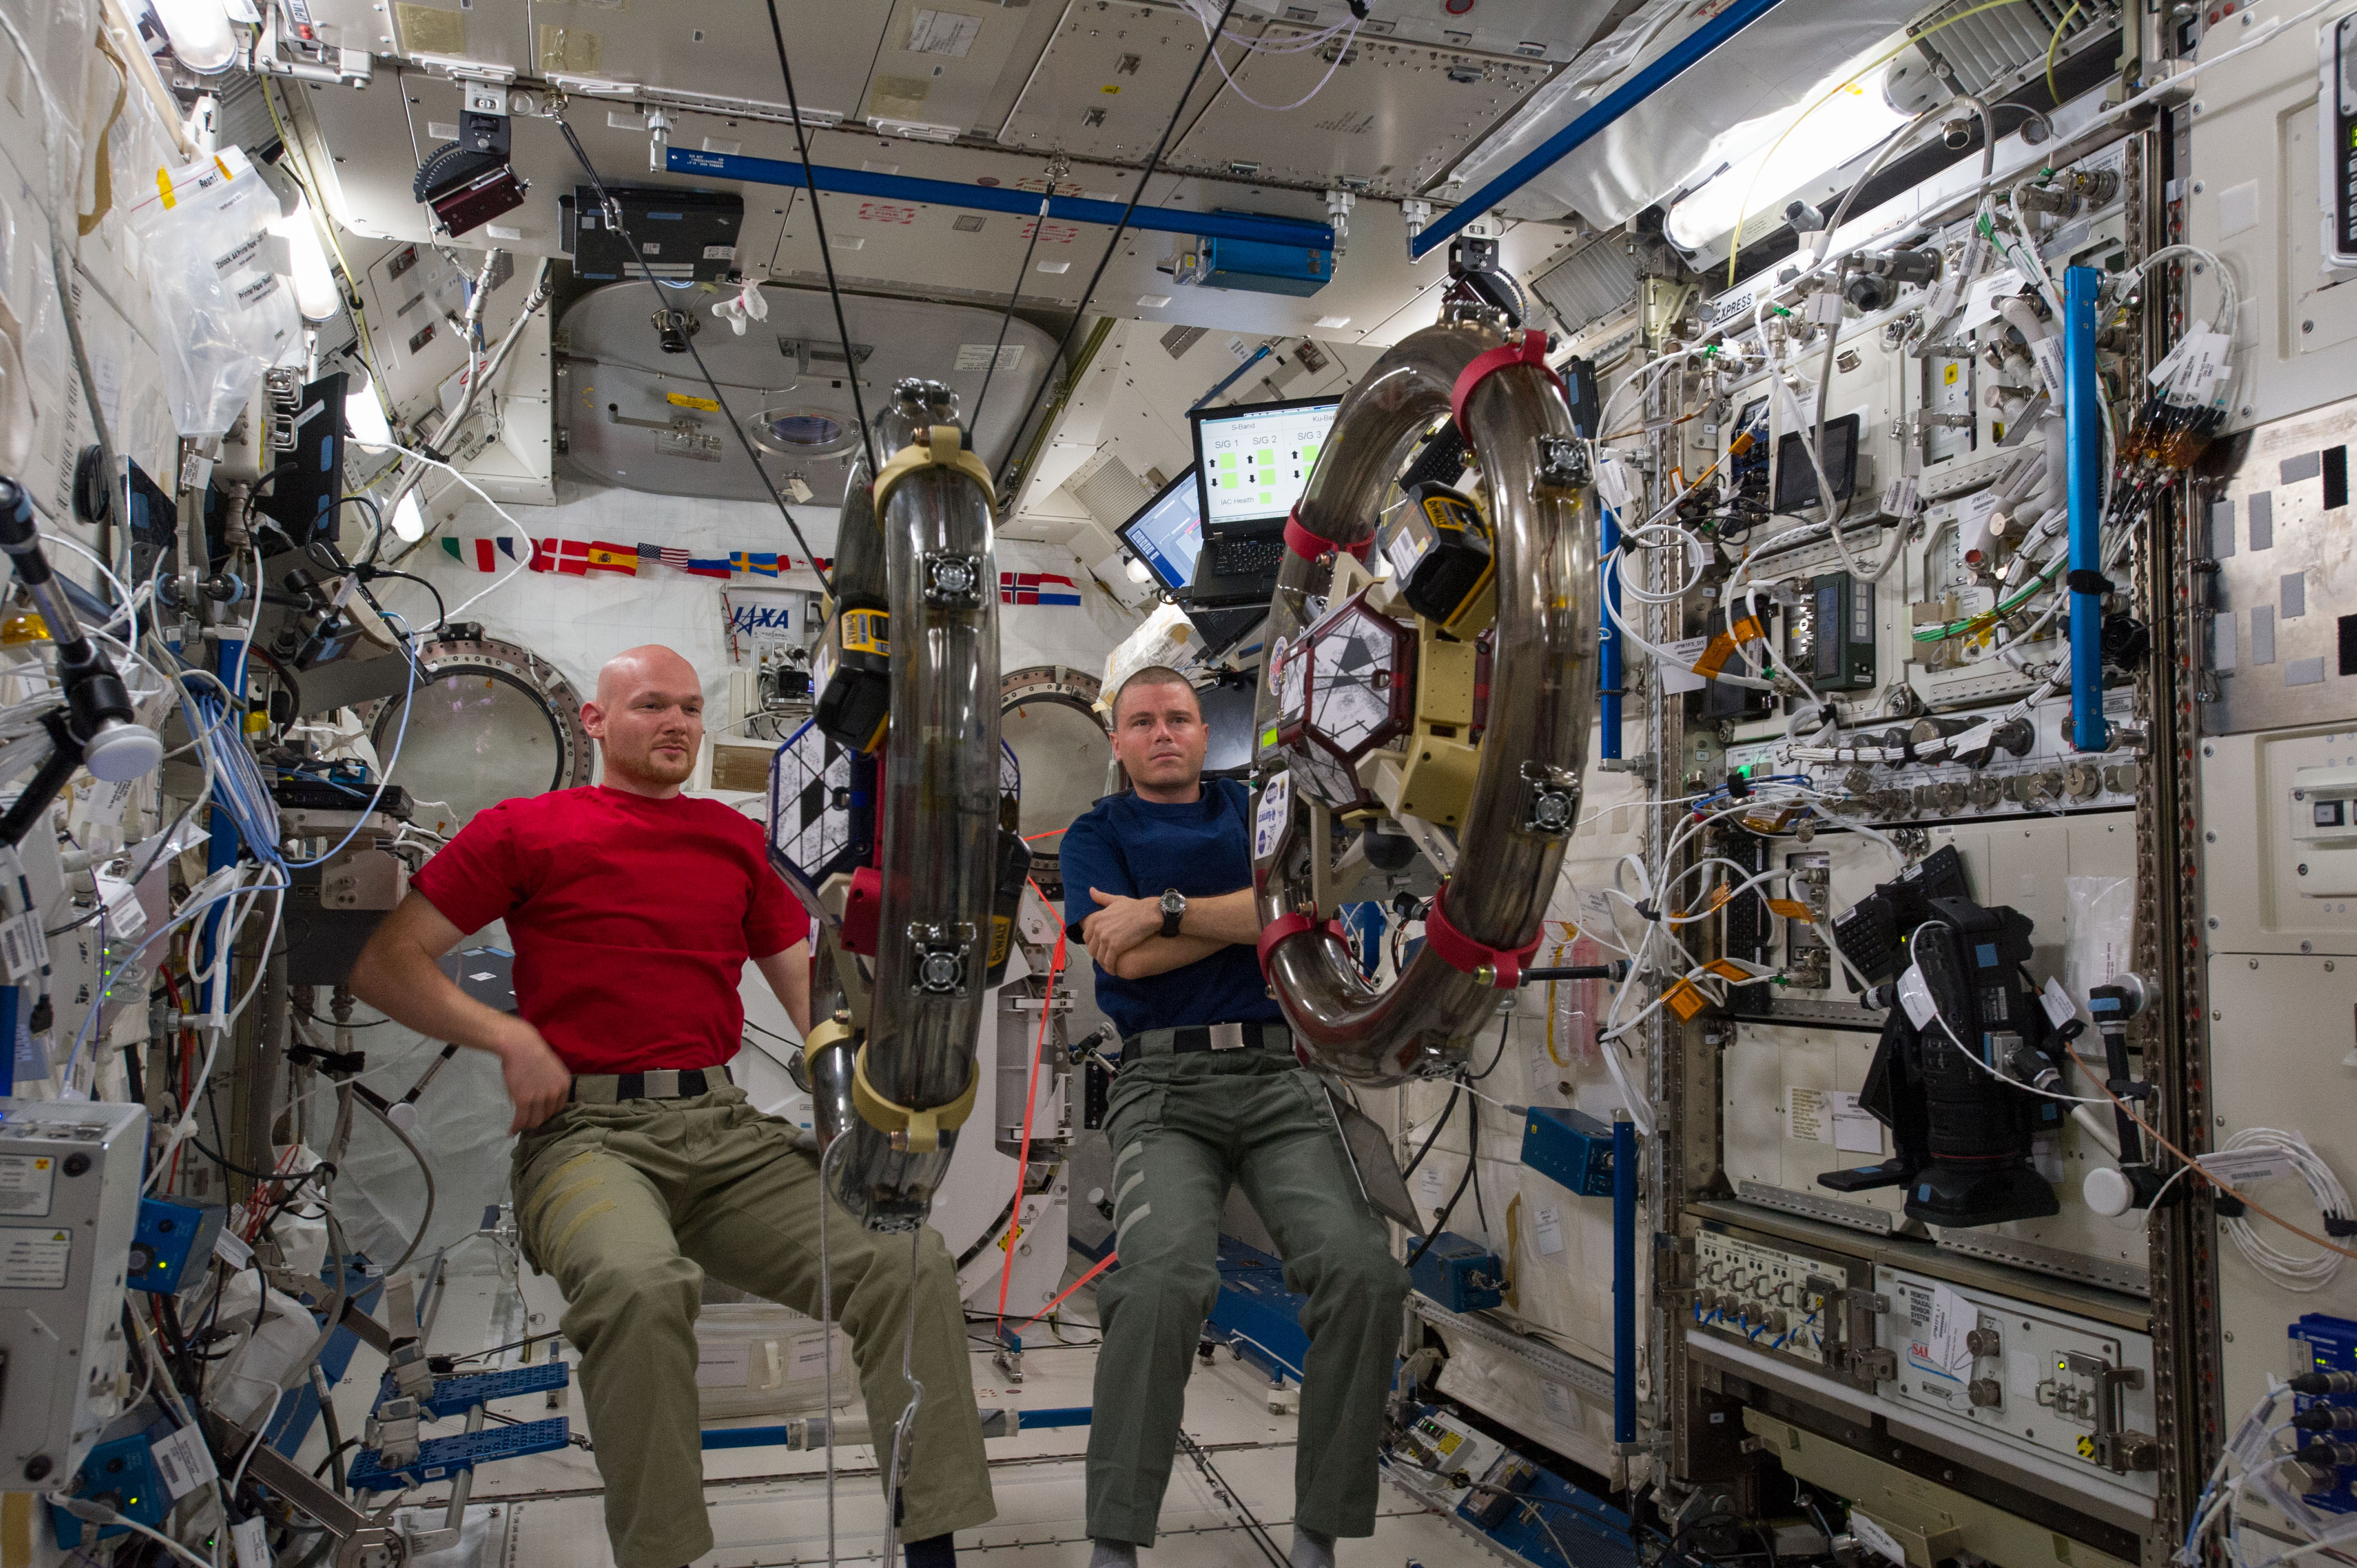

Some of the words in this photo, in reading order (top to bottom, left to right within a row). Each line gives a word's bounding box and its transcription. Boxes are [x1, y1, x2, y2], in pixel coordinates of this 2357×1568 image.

[199, 176, 214, 189] Ream
[1713, 293, 1752, 327] EXPRESS
[1232, 422, 1255, 431] S-Band
[1253, 437, 1269, 445] S/G
[1298, 432, 1314, 441] S/G
[1215, 441, 1231, 449] S/G
[733, 603, 789, 638] JAXA
[1911, 1291, 1930, 1301] REMOTE
[1911, 1297, 1932, 1309] TRIAXIAL
[1911, 1304, 1930, 1315] SENSOR
[1911, 1311, 1930, 1322] SYSTEM
[1912, 1343, 1928, 1359] SAM
